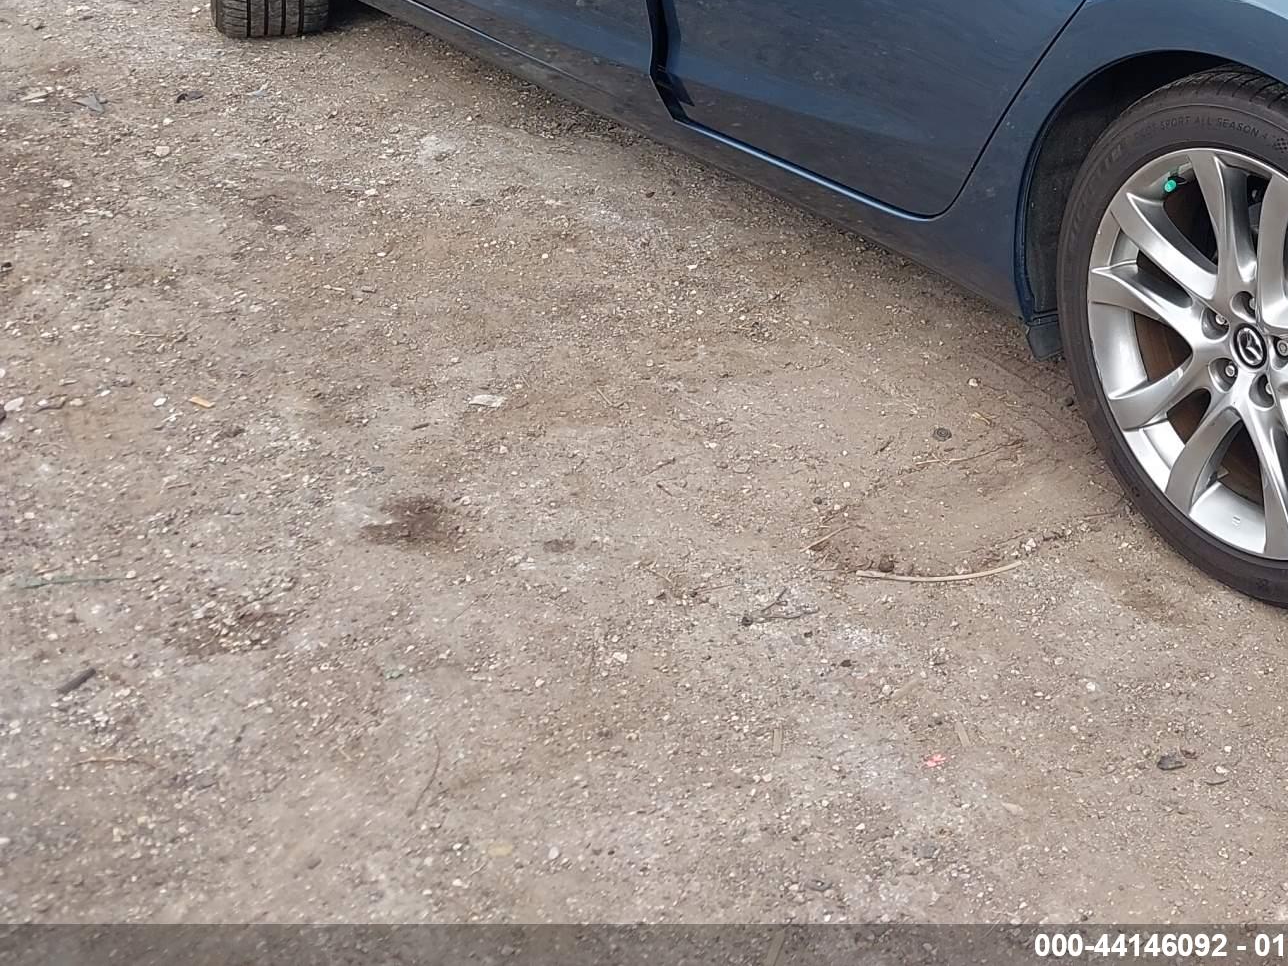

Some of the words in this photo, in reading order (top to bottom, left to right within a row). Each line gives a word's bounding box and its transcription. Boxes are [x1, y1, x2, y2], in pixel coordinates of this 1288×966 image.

[1160, 115, 1191, 131] SPORT
[1194, 114, 1213, 126] ALL
[1217, 116, 1260, 138] SEASON
